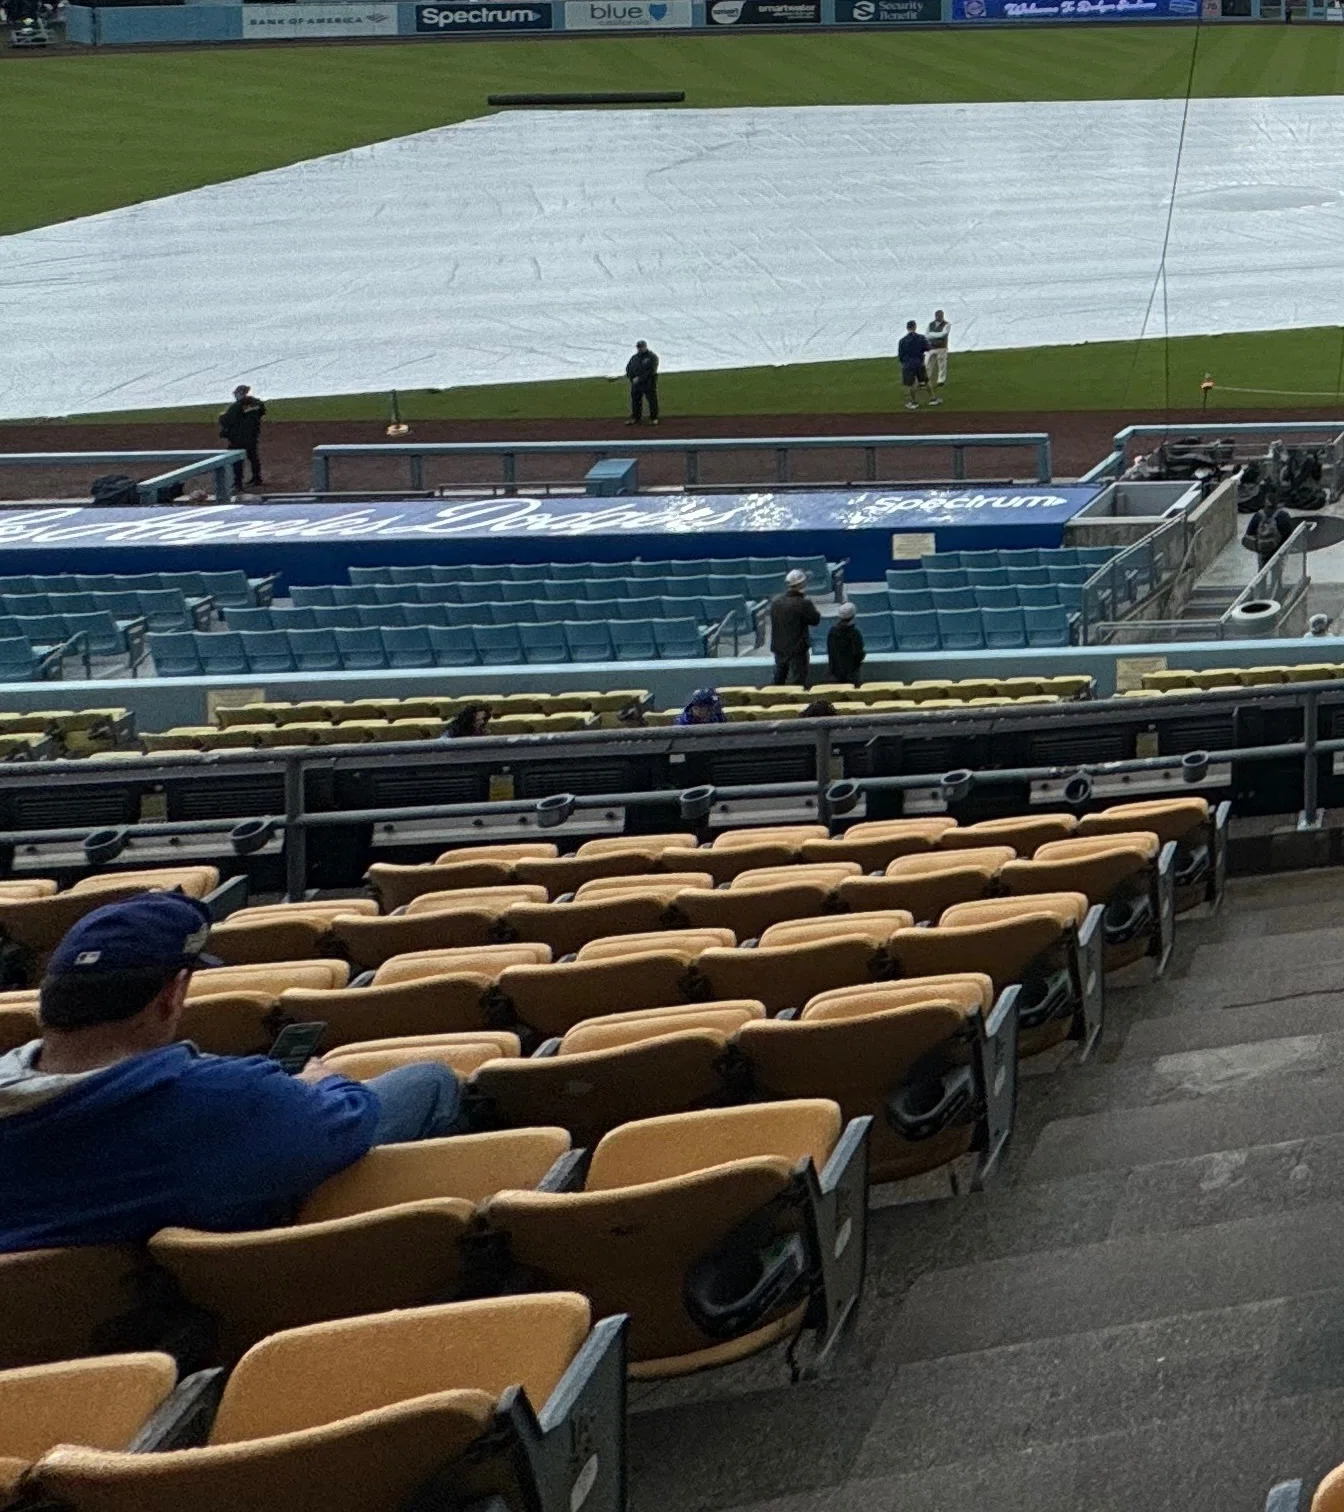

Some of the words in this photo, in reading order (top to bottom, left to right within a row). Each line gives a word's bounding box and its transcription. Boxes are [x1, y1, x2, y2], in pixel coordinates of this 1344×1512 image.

[878, 1, 924, 13] Security
[422, 8, 533, 27] Spectrum
[590, 3, 643, 19] blue
[880, 12, 918, 21] Benefit
[874, 494, 1056, 513] Spectrum
